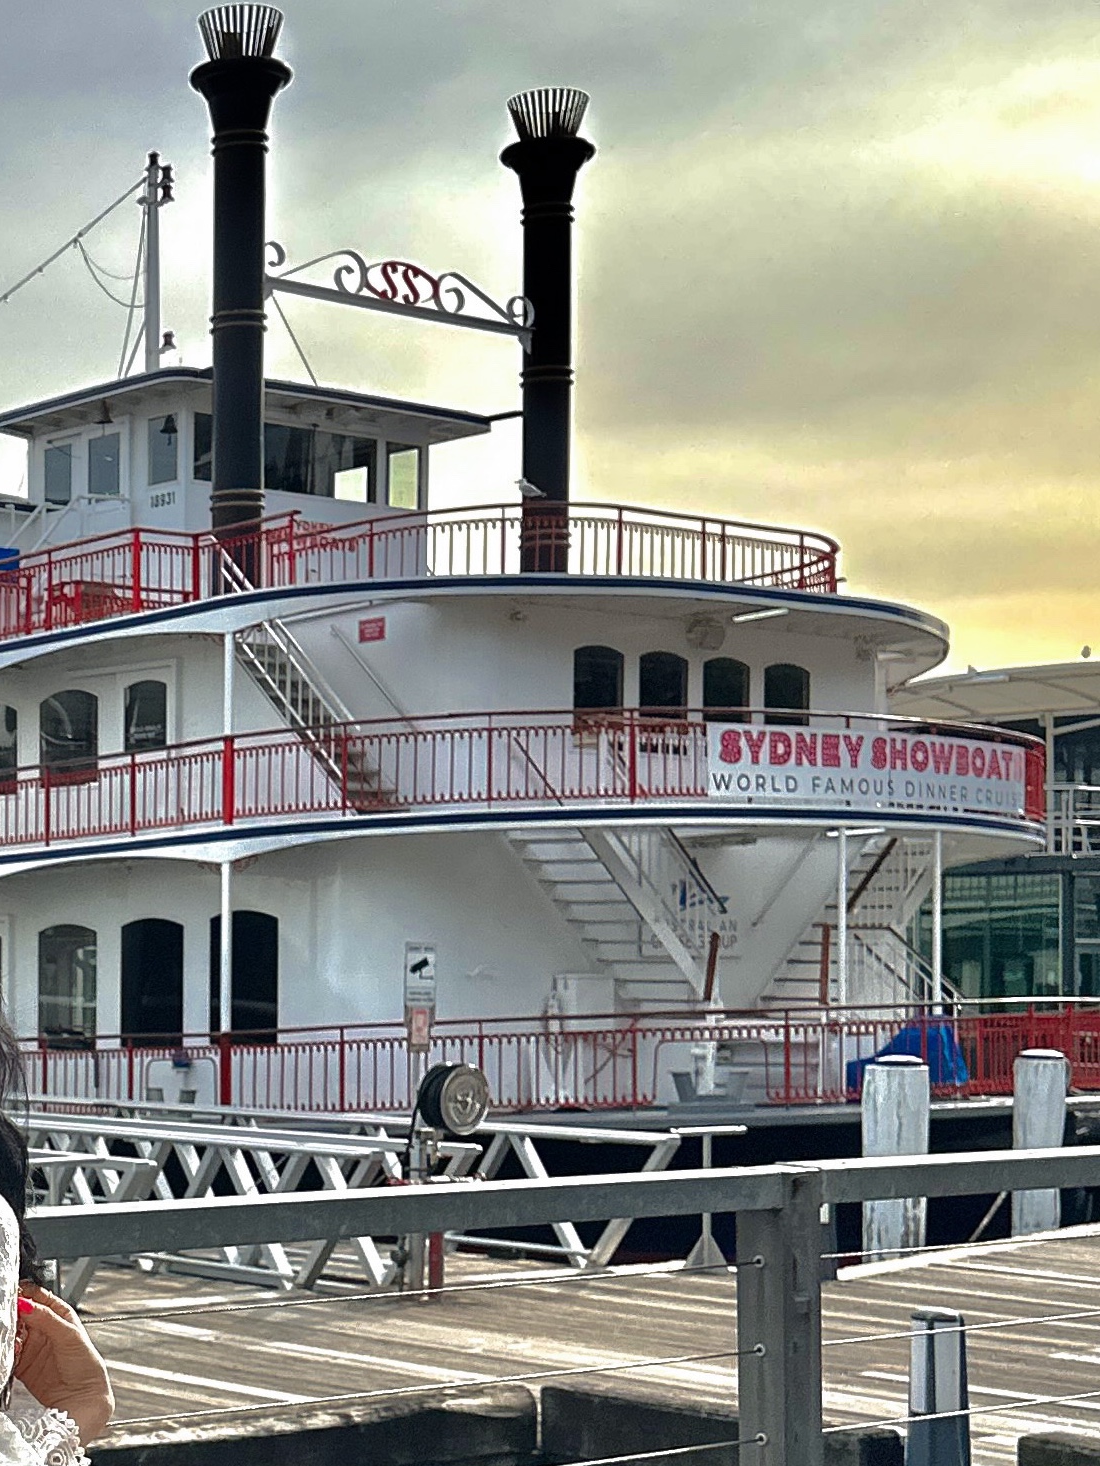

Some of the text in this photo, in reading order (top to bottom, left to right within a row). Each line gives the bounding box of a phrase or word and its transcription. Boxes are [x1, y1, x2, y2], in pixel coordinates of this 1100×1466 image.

[719, 729, 864, 769] SYDNEY
[712, 772, 798, 793] WORLD
[811, 775, 894, 796] FAMOUS
[904, 780, 967, 802] DINNER
